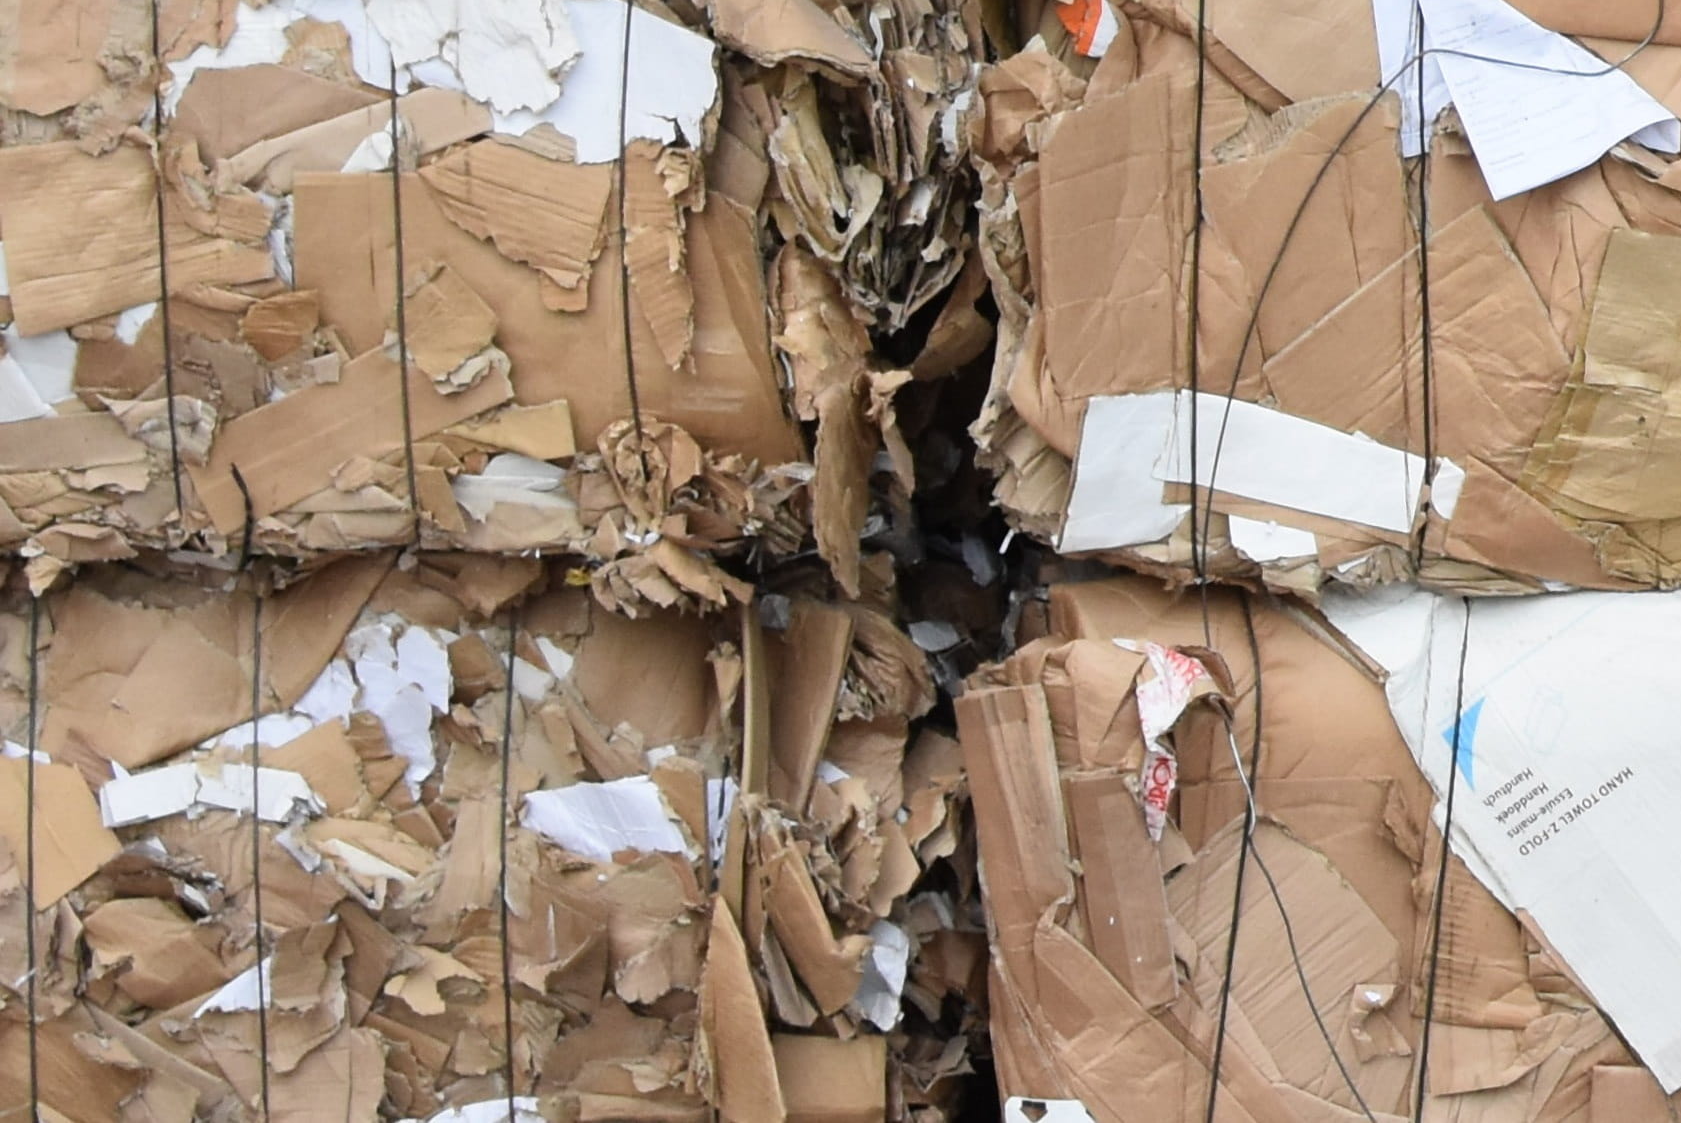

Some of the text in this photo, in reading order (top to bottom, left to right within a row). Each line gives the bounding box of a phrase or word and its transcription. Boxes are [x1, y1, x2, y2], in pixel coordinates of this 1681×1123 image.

[1483, 767, 1534, 807] Handtuch
[1496, 782, 1549, 824] Handdoek
[1507, 787, 1573, 839] Essuie-mains
[1518, 766, 1634, 857] HAND TOWEL Z-FOLD
